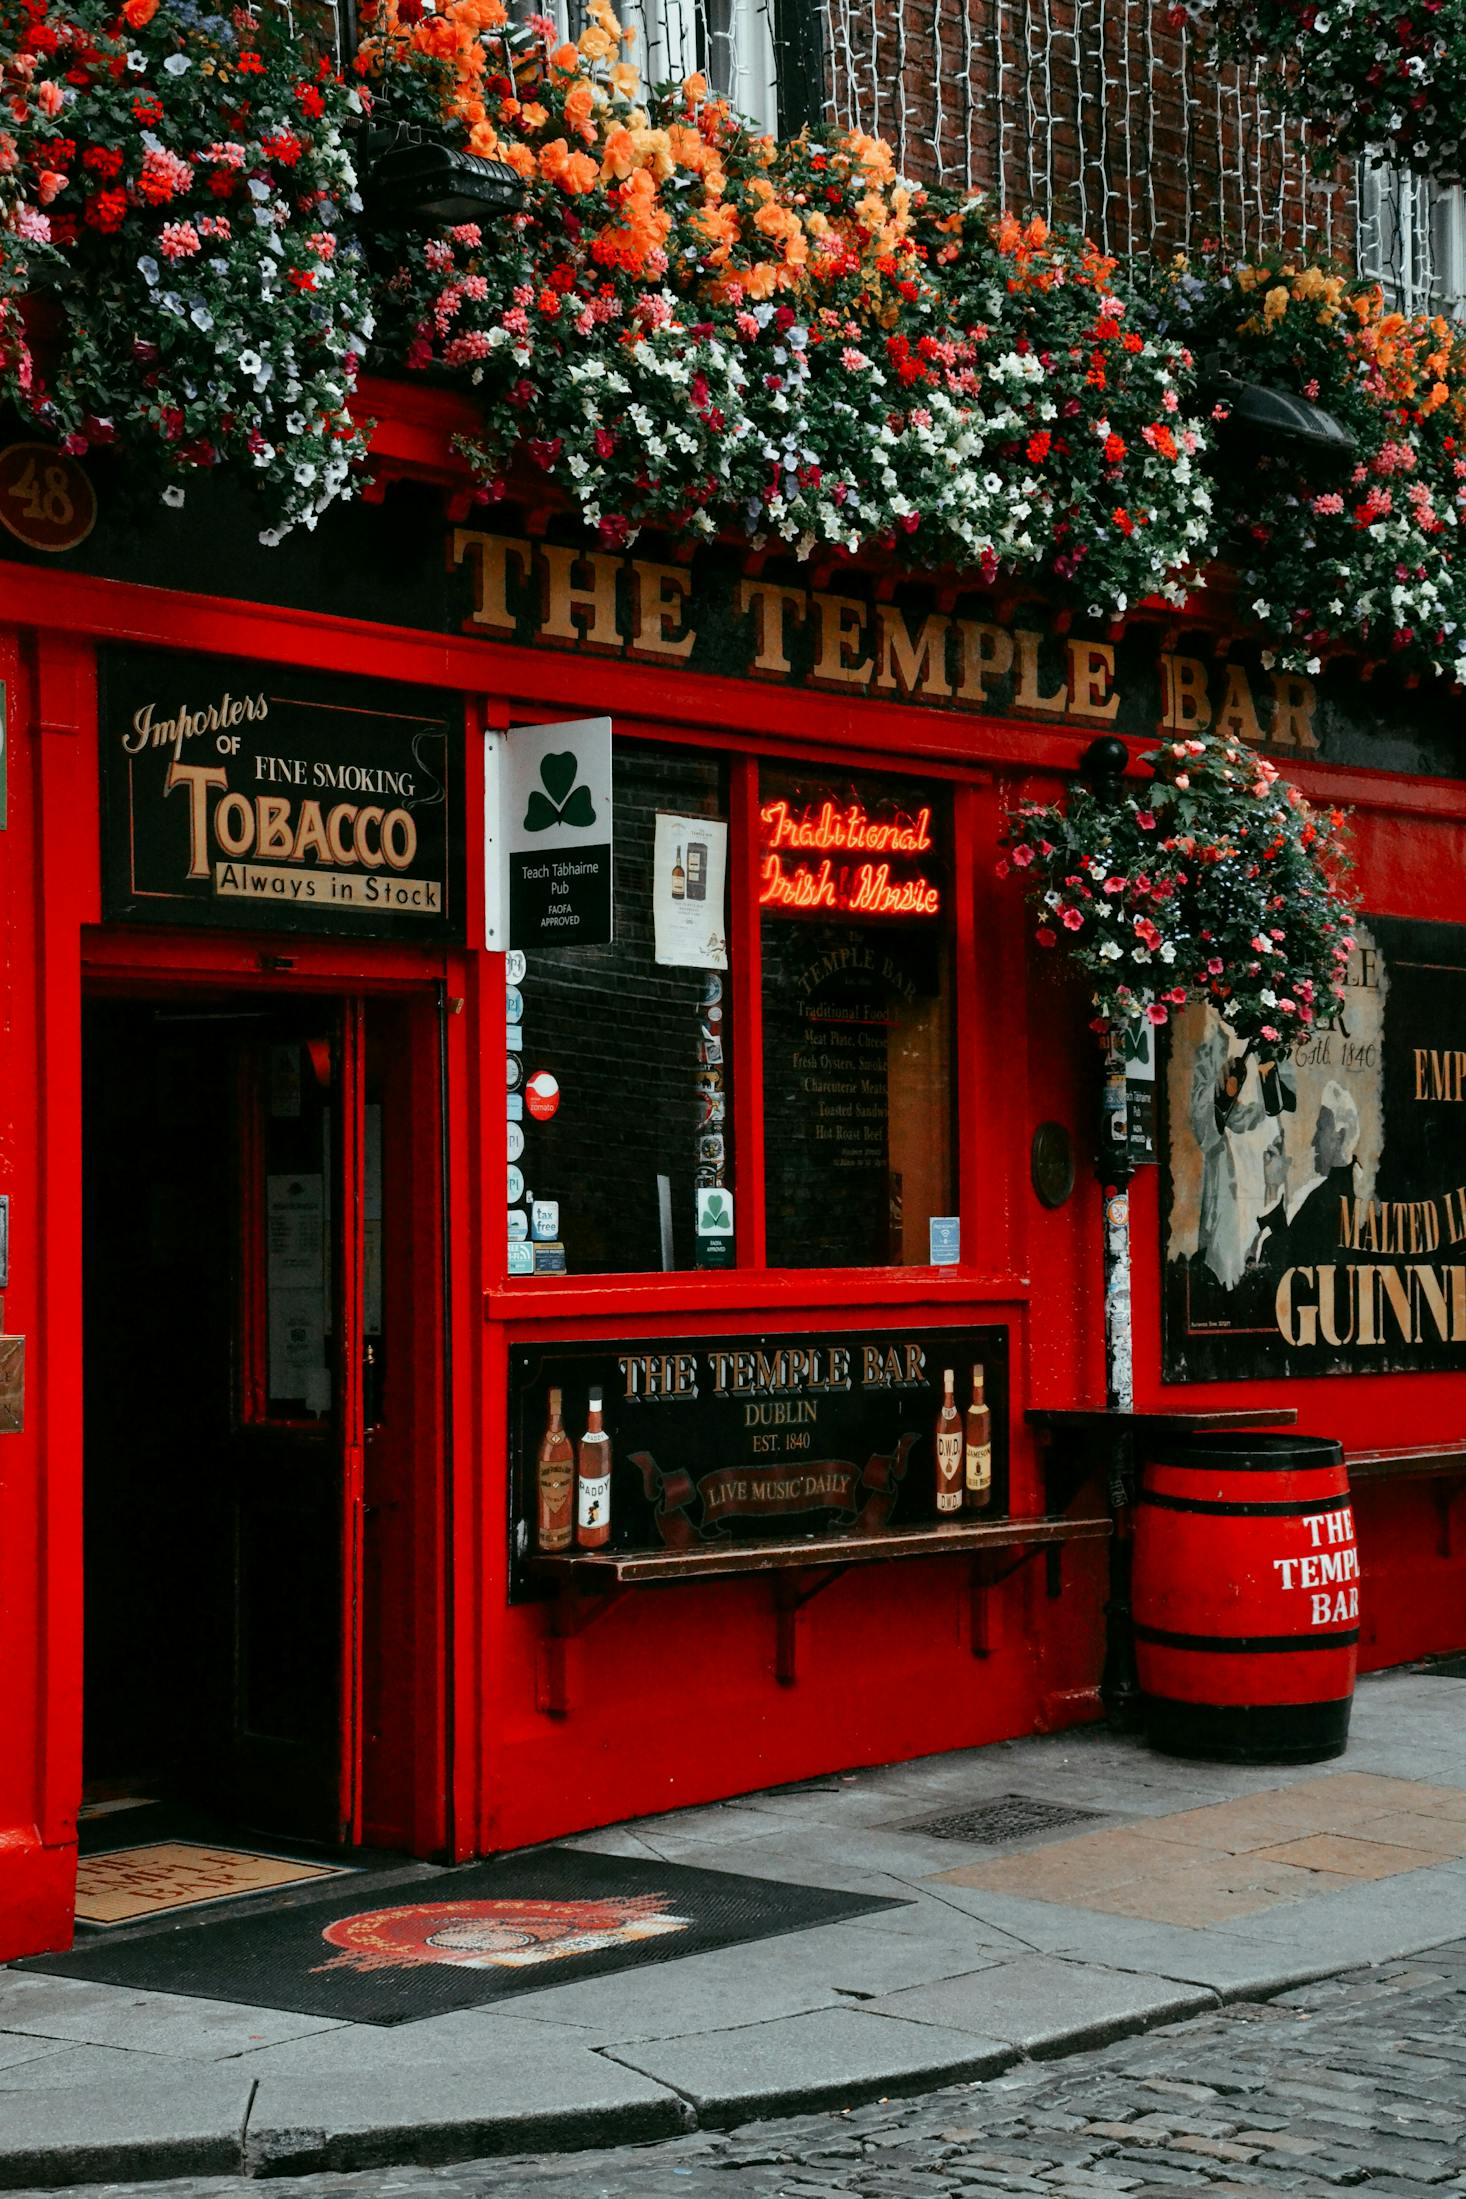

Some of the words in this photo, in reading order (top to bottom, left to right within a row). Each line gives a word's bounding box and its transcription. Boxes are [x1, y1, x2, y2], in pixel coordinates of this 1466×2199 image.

[8, 458, 74, 525] 48
[450, 528, 697, 662] THE
[738, 579, 1122, 722] TEMPLE
[1161, 654, 1320, 748] BAR
[122, 693, 268, 762] Importers
[216, 735, 241, 755] OF
[255, 756, 307, 785] FINE
[313, 763, 415, 796] SMOKING
[164, 761, 417, 880] TOBACCO
[761, 801, 932, 851] Traditional
[522, 864, 549, 879] Teach
[552, 861, 599, 877] Tábhairne
[760, 854, 836, 906] Irish
[849, 863, 939, 914] Music
[220, 864, 316, 898] Always
[331, 877, 353, 899] in
[366, 877, 437, 907] Stock
[551, 881, 570, 895] Pub
[540, 915, 580, 928] APPROVED
[797, 1000, 859, 1019] Traditional
[864, 1004, 890, 1020] Food
[793, 1052, 817, 1068] Fresh
[804, 1077, 857, 1093] Charcuterie
[530, 1103, 554, 1112] zomato
[537, 1208, 553, 1219] tax
[537, 1221, 557, 1233] free
[1338, 1195, 1440, 1254] MALTED
[618, 1353, 698, 1402] THE
[708, 1346, 851, 1398] TEMPLE
[861, 1343, 930, 1391] BAR
[745, 1400, 817, 1426] DUBLIN
[753, 1434, 780, 1453] EST.
[786, 1432, 810, 1450] 1840
[579, 1478, 610, 1497] PADDY
[708, 1481, 747, 1506] LIVE
[752, 1480, 802, 1501] MUSIC
[806, 1476, 851, 1495] DAILY
[1302, 1508, 1353, 1548] THE
[1311, 1587, 1359, 1625] BAR
[127, 1873, 260, 1901] BAR
